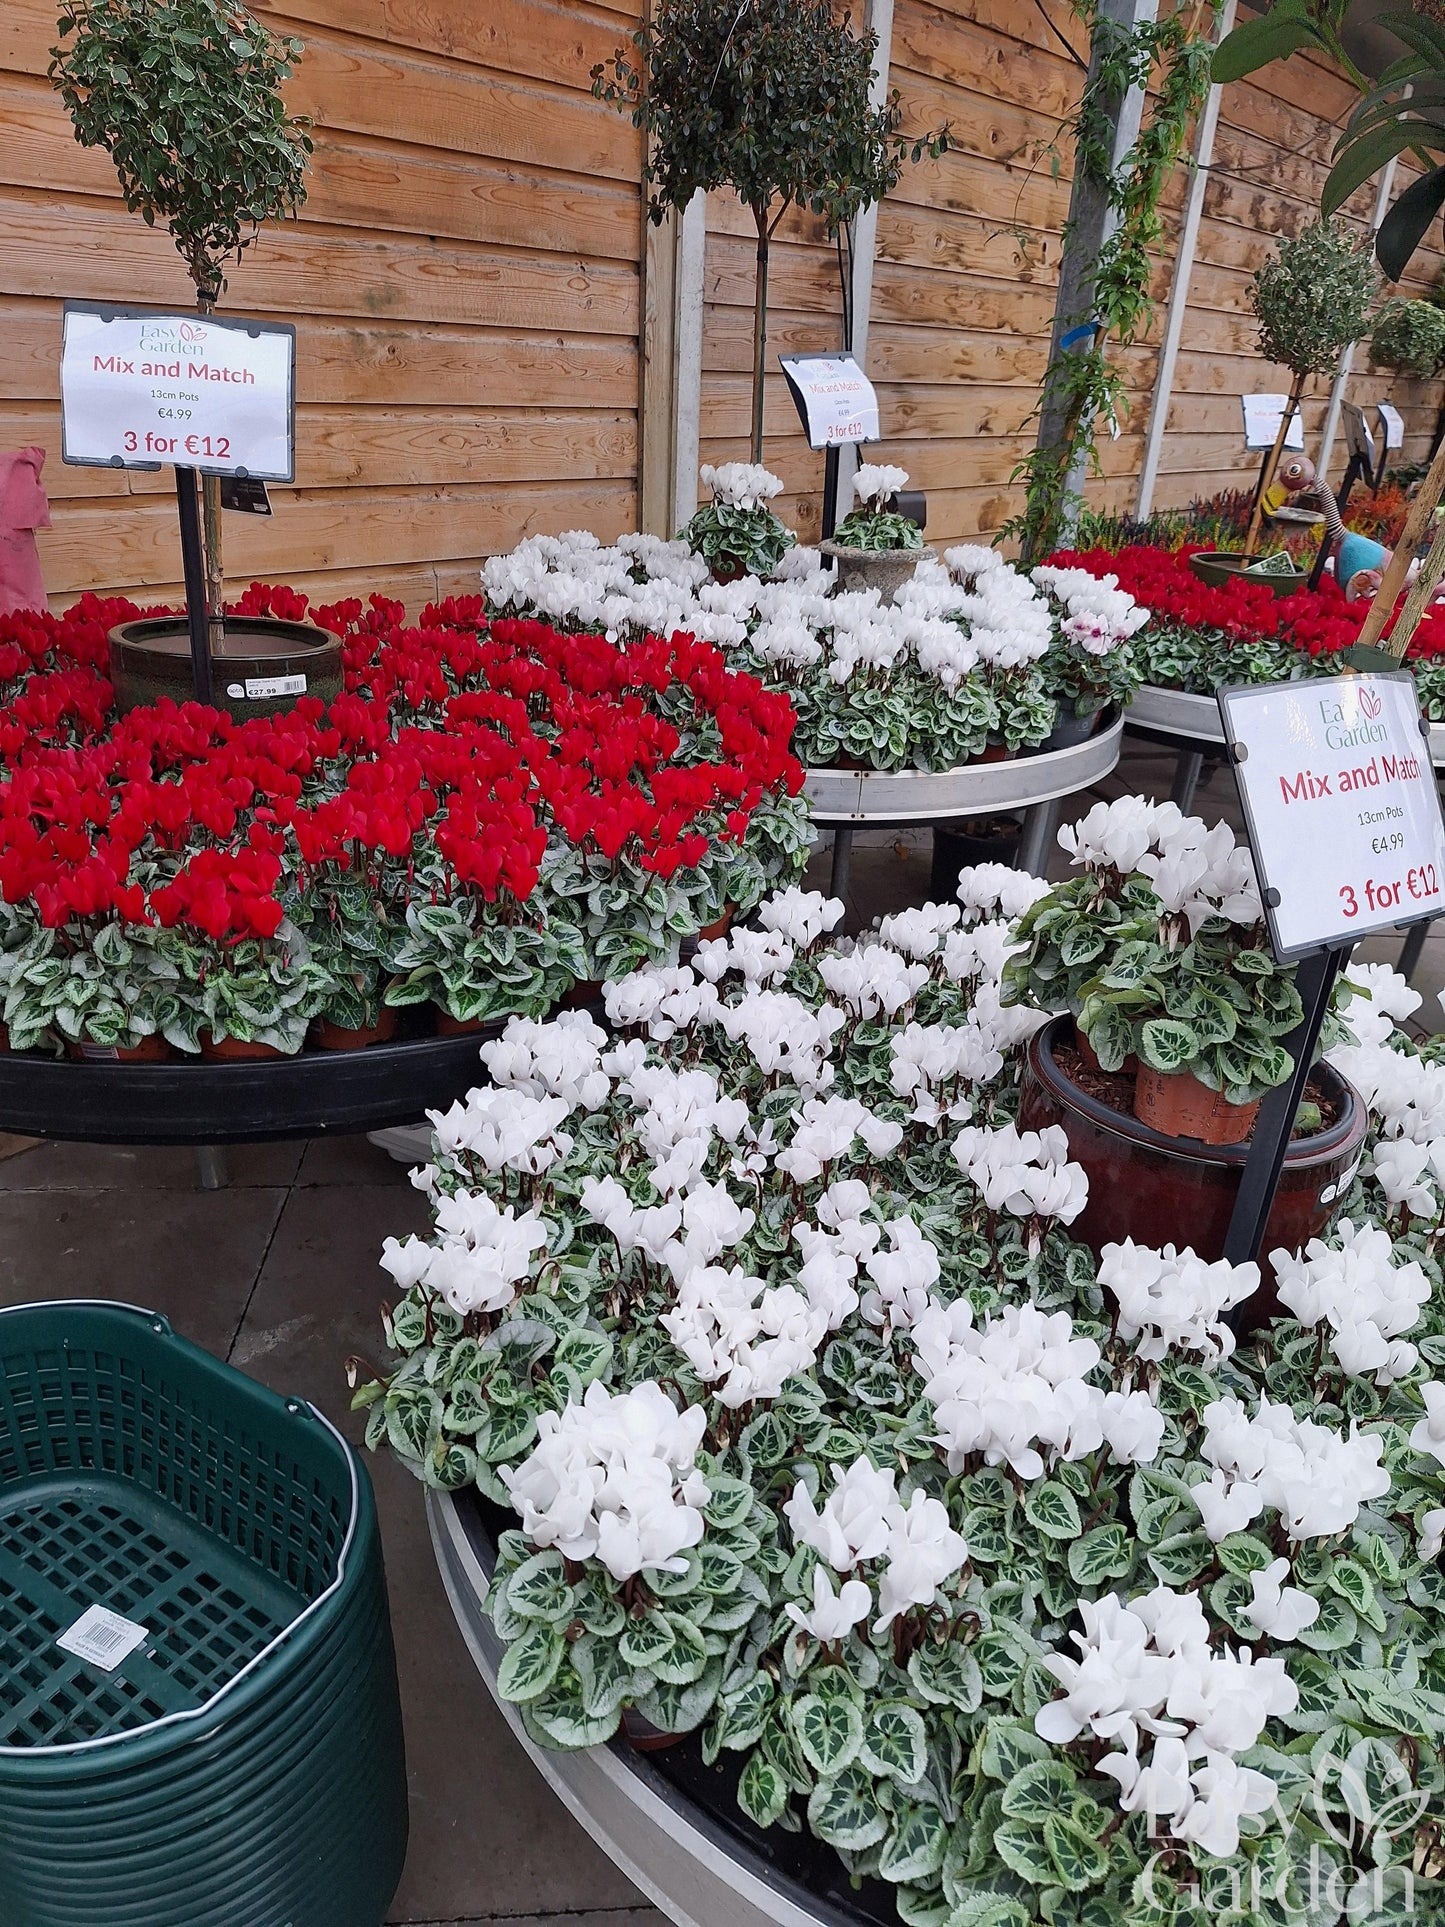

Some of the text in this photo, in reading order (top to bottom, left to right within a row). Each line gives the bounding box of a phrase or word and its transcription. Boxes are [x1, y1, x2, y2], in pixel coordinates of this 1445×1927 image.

[141, 325, 179, 342] Easy
[139, 338, 204, 356] Garden
[93, 356, 255, 384] Mix and Match
[151, 389, 199, 402] 13cm Pots
[809, 380, 863, 394] Mix and Match
[158, 408, 192, 420] €4.99
[828, 422, 862, 438] 3 for €12
[124, 431, 231, 458] 3 for €12
[1325, 719, 1388, 750] Garden
[1279, 751, 1421, 804] Mix and Match
[1357, 806, 1404, 826] 13cm Pots
[1371, 832, 1404, 854] €4.99
[1339, 864, 1439, 918] 3 for €12
